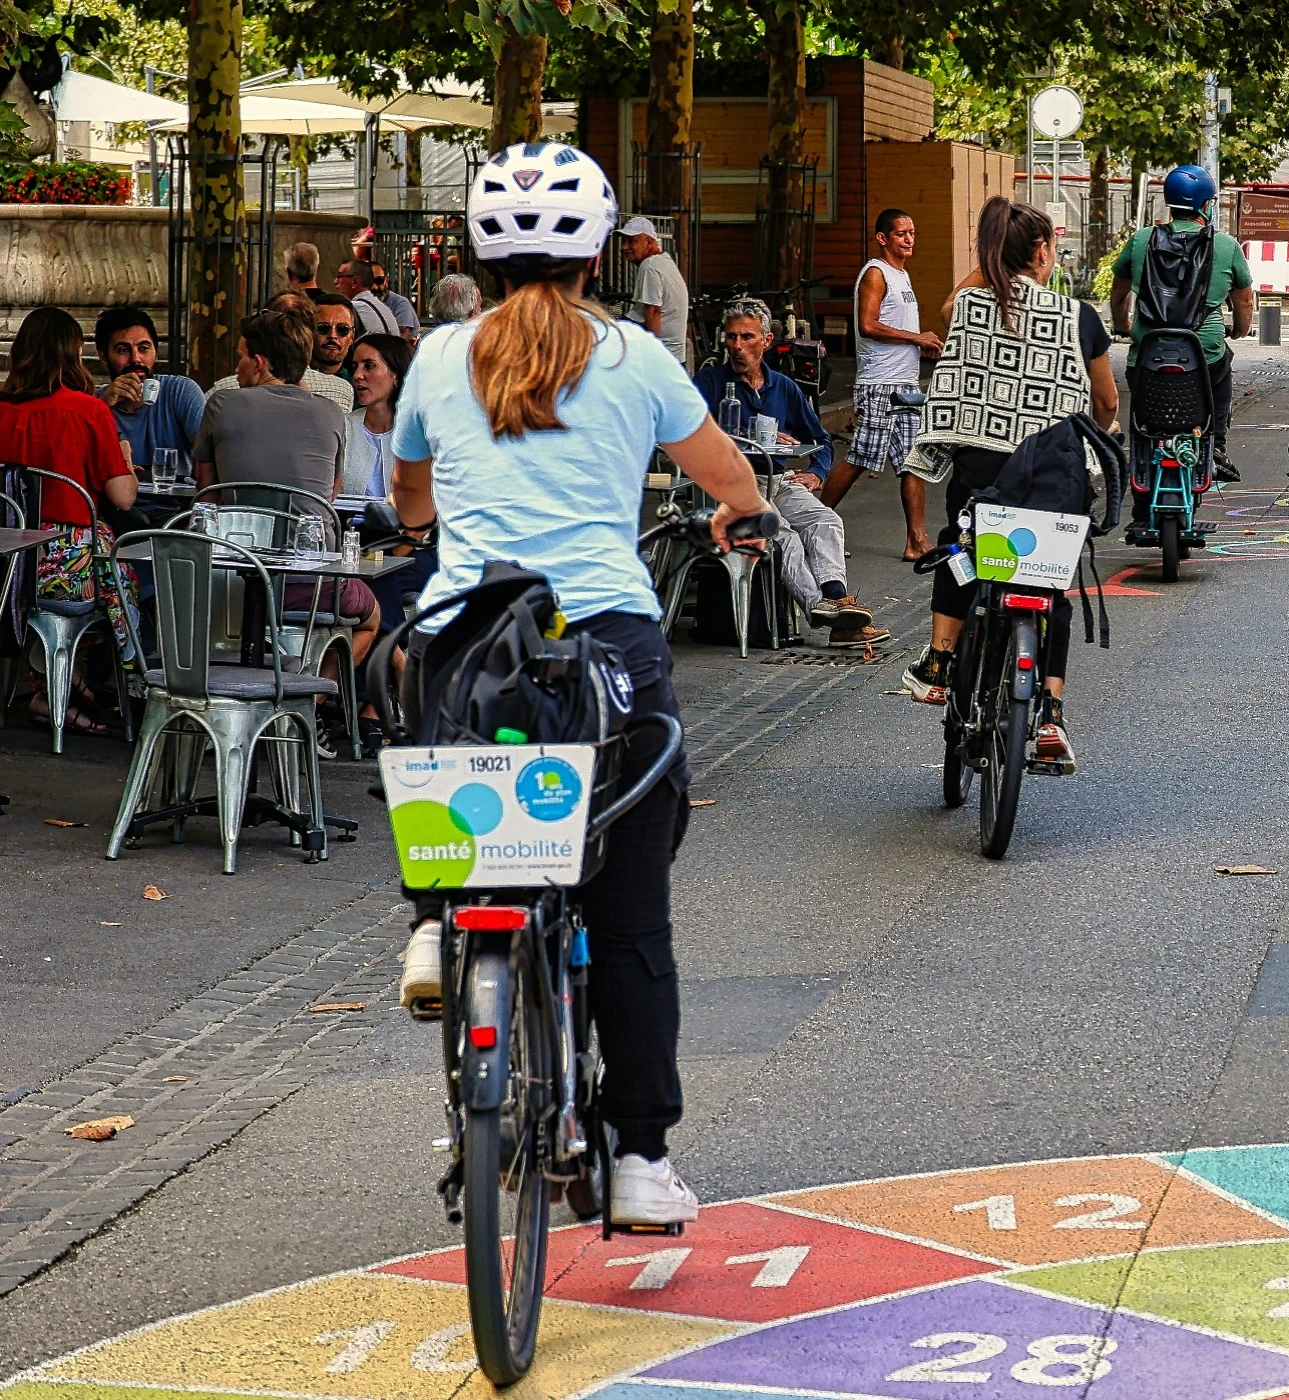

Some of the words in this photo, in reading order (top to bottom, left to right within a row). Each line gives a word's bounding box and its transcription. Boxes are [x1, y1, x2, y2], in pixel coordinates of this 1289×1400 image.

[988, 510, 1007, 519] imad
[1055, 521, 1079, 534] 19053
[981, 556, 1016, 569] santé
[1020, 561, 1070, 574] mobilité
[469, 755, 511, 772] 19021
[408, 840, 471, 862] santé
[481, 838, 573, 860] mobilité
[953, 1193, 1149, 1231] 12
[604, 1245, 812, 1291] 11
[885, 1331, 1119, 1388] 28
